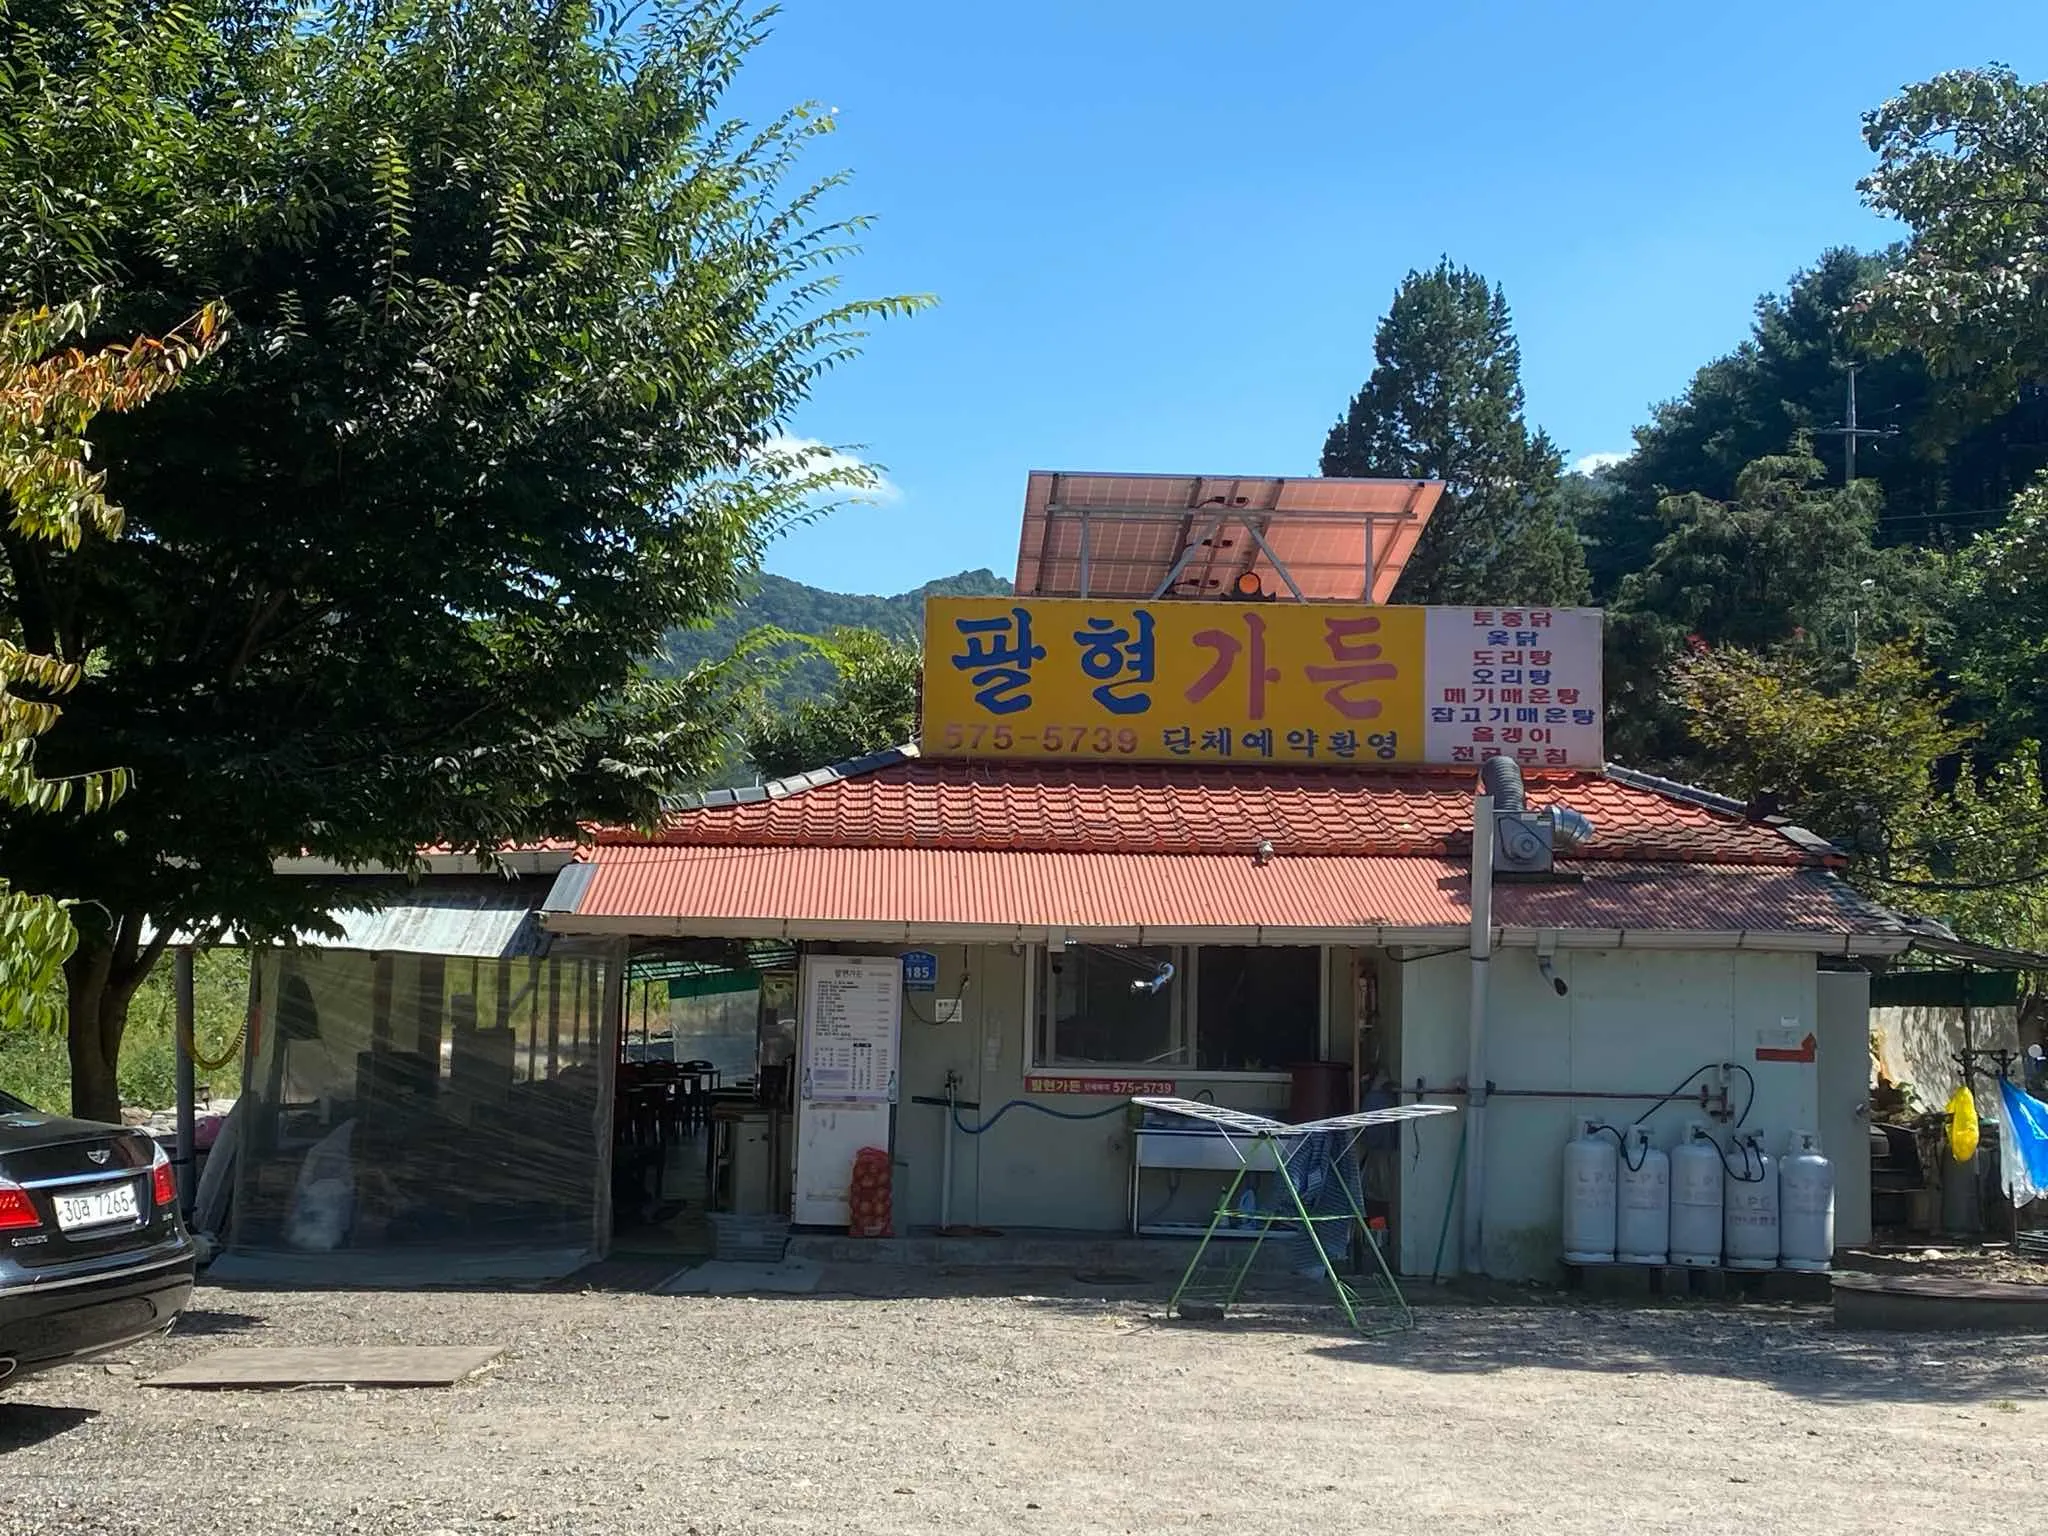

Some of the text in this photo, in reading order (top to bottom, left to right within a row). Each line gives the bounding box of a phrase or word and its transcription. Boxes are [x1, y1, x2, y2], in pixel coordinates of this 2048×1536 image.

[1473, 611, 1552, 628] 토종닭
[1473, 651, 1552, 666] 도리탕
[1472, 668, 1552, 686] 오리탕
[1444, 688, 1580, 705] 메기매운탕
[1432, 707, 1595, 725] 잡고기매운탕
[944, 722, 1138, 755] 575-5739
[1472, 726, 1552, 744] 올갱이
[905, 967, 929, 978] 185
[1112, 1081, 1172, 1094] 575-5739
[94, 1190, 130, 1216] 7265
